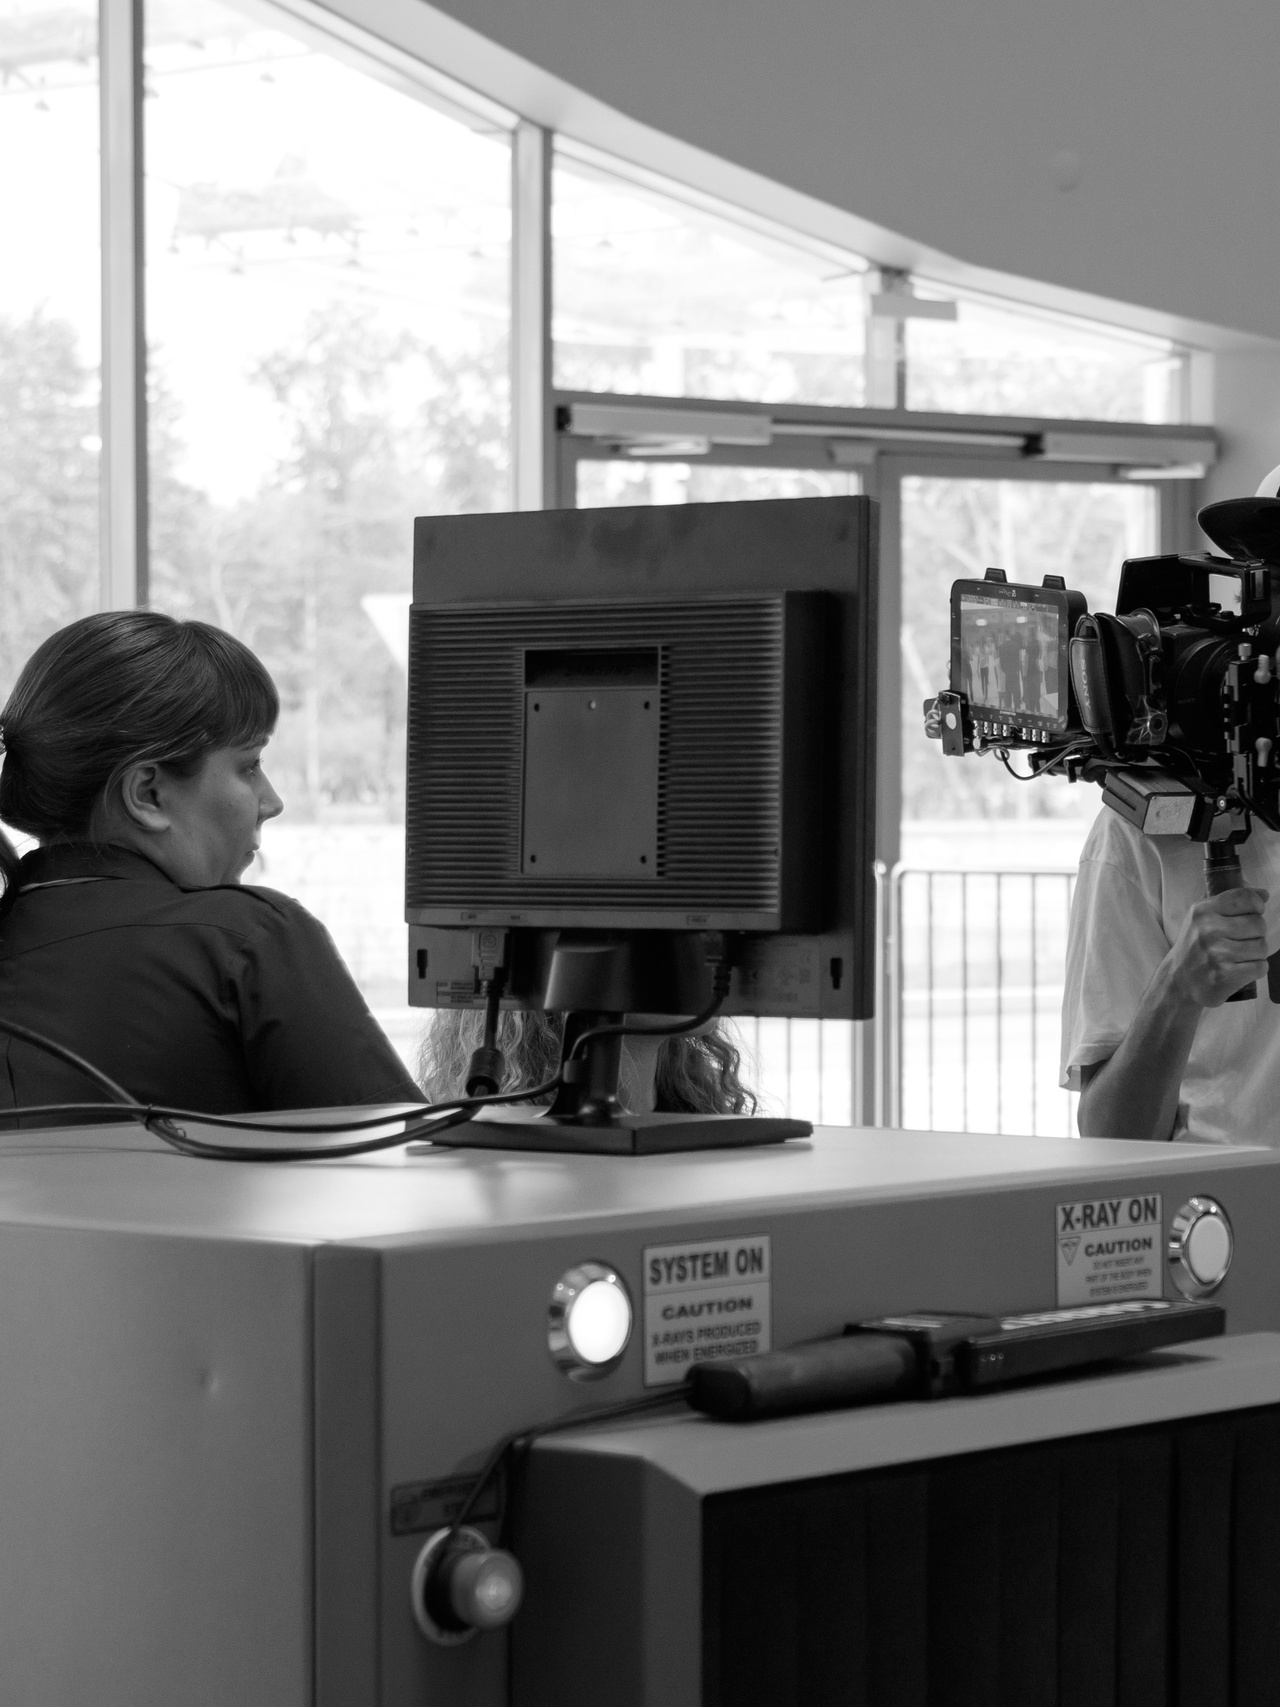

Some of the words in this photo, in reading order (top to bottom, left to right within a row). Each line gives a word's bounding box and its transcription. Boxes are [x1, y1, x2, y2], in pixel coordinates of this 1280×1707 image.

[1081, 658, 1092, 711] SONY
[1061, 1201, 1122, 1232] X-RAY
[1129, 1197, 1157, 1224] ON
[1084, 1238, 1153, 1257] CAUTION
[649, 1250, 729, 1285] SYSTEM
[735, 1247, 763, 1275] ON
[661, 1298, 753, 1320] CAUTION
[696, 1321, 762, 1341] PRODUCED
[654, 1348, 690, 1364] WHEN
[693, 1339, 759, 1360] ENERGIZED
